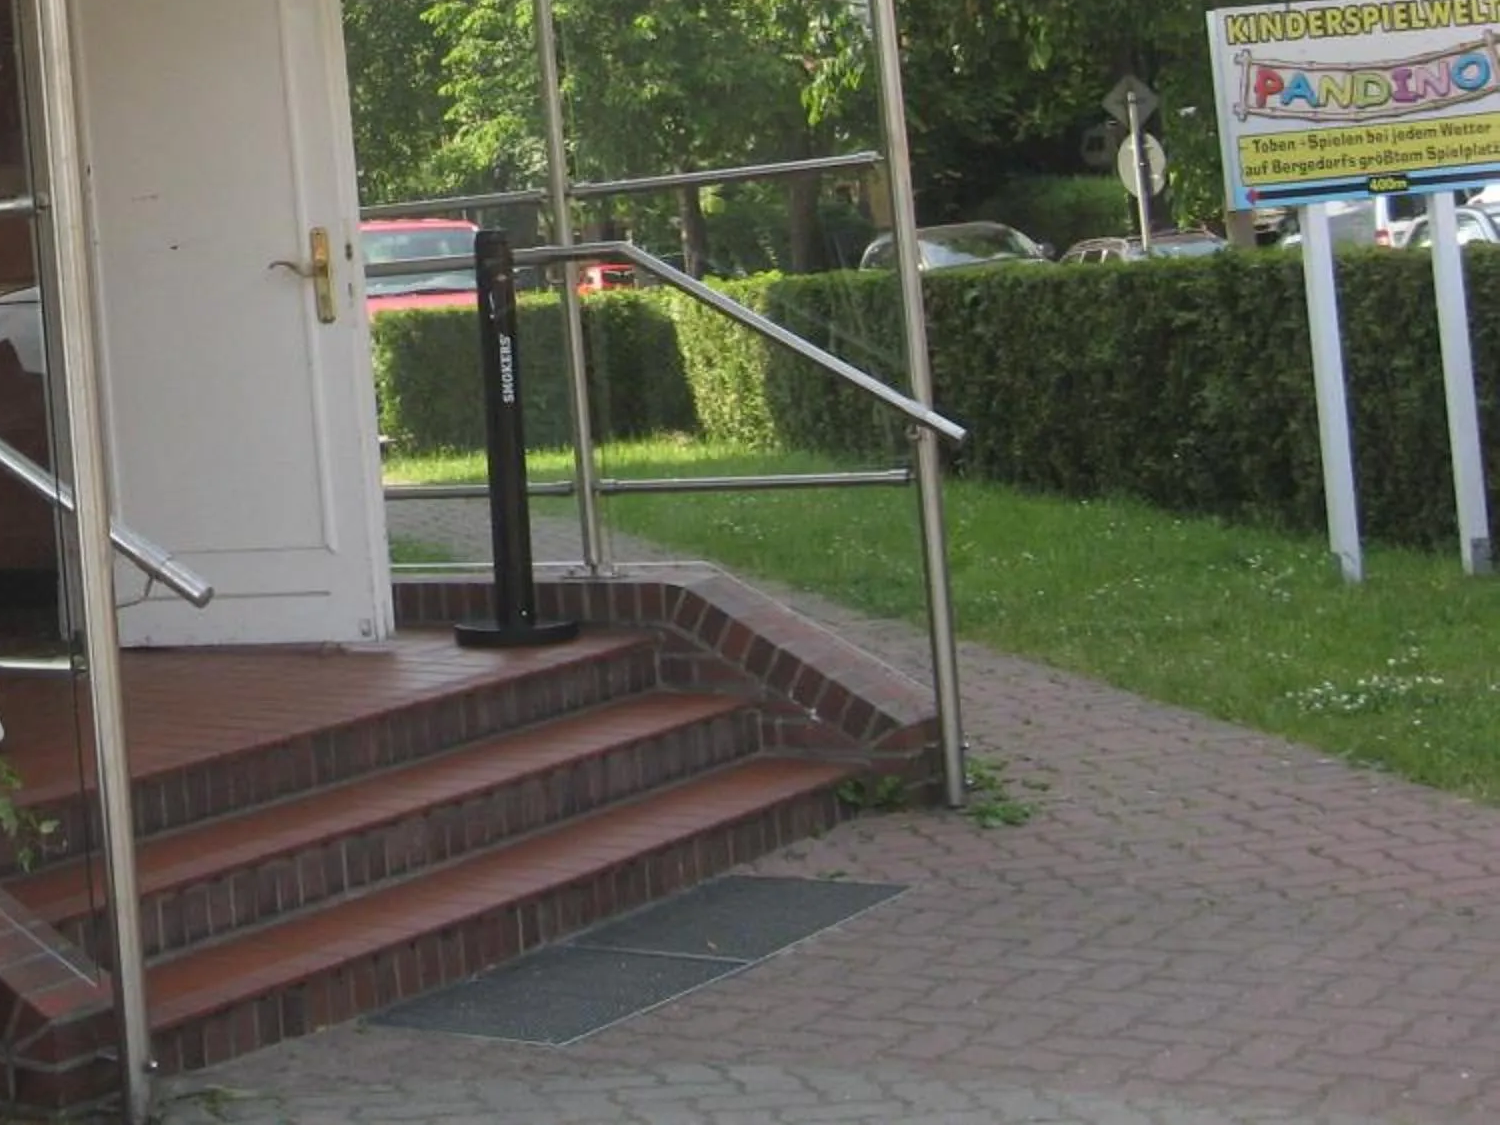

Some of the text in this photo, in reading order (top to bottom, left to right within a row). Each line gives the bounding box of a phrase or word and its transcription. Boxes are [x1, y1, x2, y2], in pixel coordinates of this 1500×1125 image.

[1254, 52, 1492, 108] PANDINO
[1251, 138, 1296, 154] Toben
[1307, 132, 1364, 151] Spielen
[1365, 127, 1389, 144] bei
[1391, 125, 1437, 144] jedem
[1439, 121, 1492, 137] Wetter
[1245, 160, 1269, 177] auf
[1270, 153, 1358, 176] Bergedorfs
[1425, 141, 1500, 163] Spielplatz
